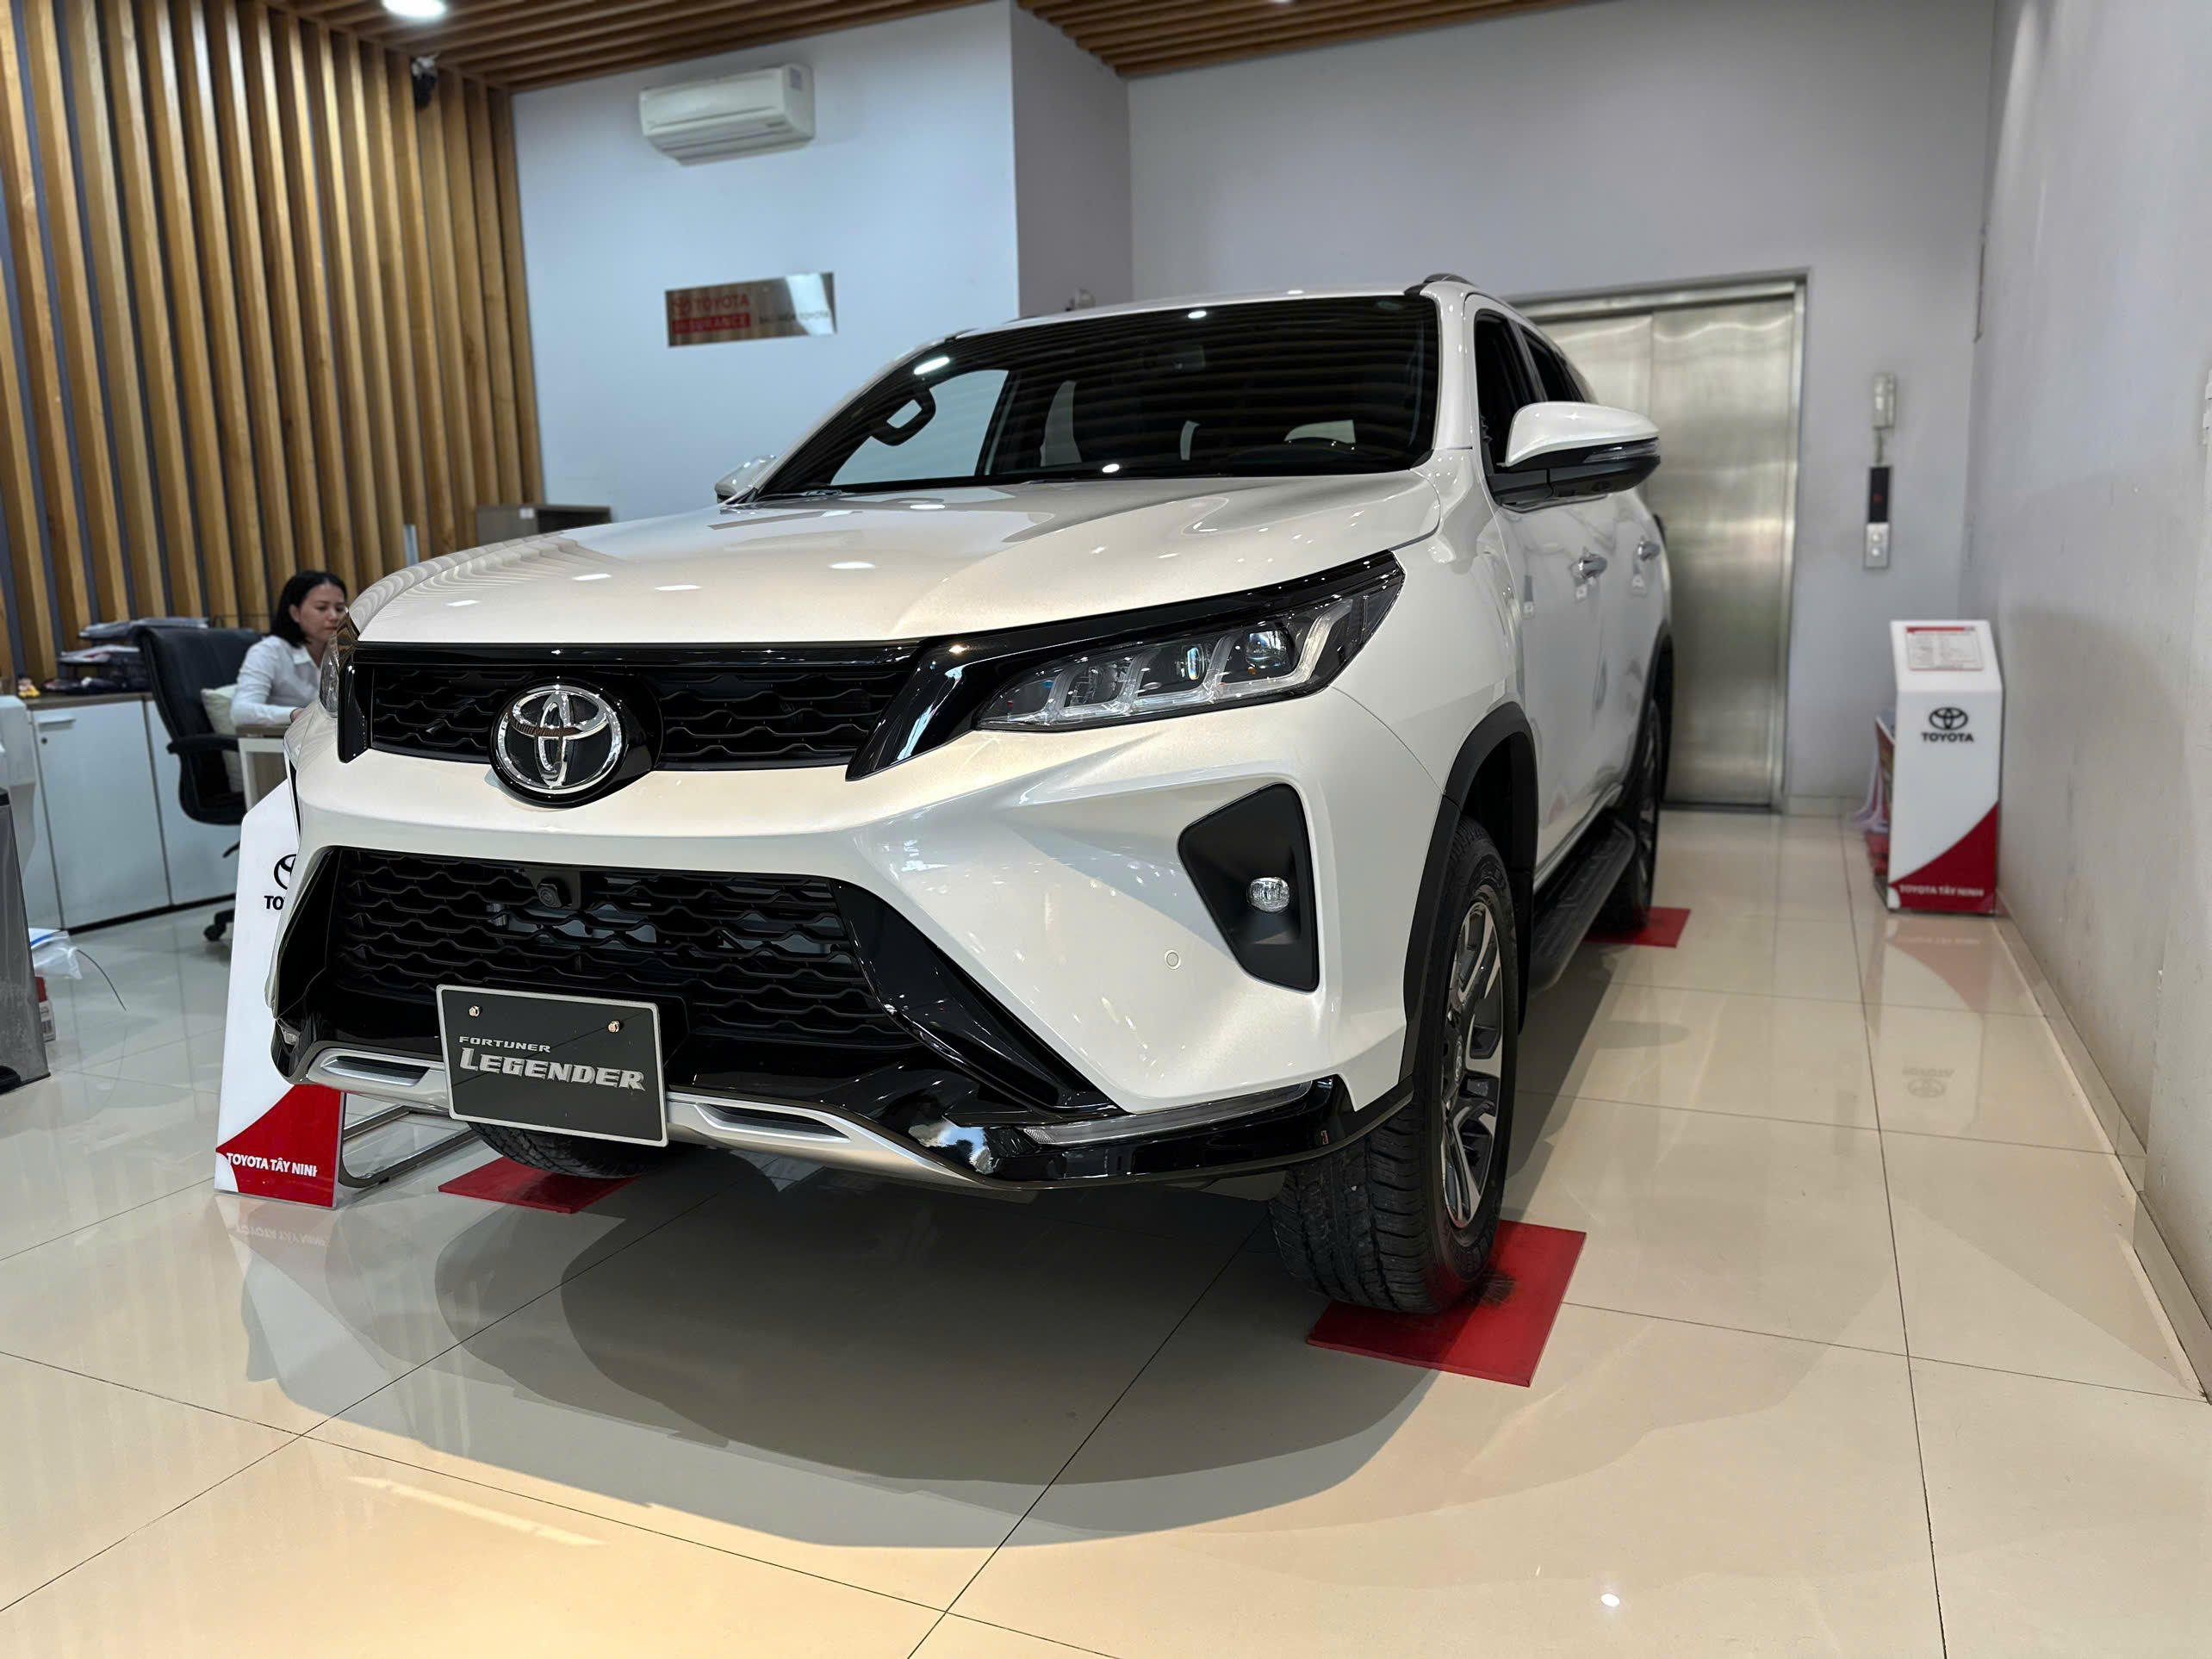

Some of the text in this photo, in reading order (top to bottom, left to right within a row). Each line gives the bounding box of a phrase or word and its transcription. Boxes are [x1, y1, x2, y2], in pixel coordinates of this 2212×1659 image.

[696, 294, 749, 311] TOYOTA
[1922, 732, 1974, 743] TOYOTA
[1898, 885, 1937, 895] TOYOTA
[264, 895, 285, 910] TO
[459, 1035, 551, 1053] FORTUNER
[459, 1047, 646, 1092] LEGENDER
[227, 1153, 269, 1170] TOYOTA
[270, 1157, 291, 1172] TÂY
